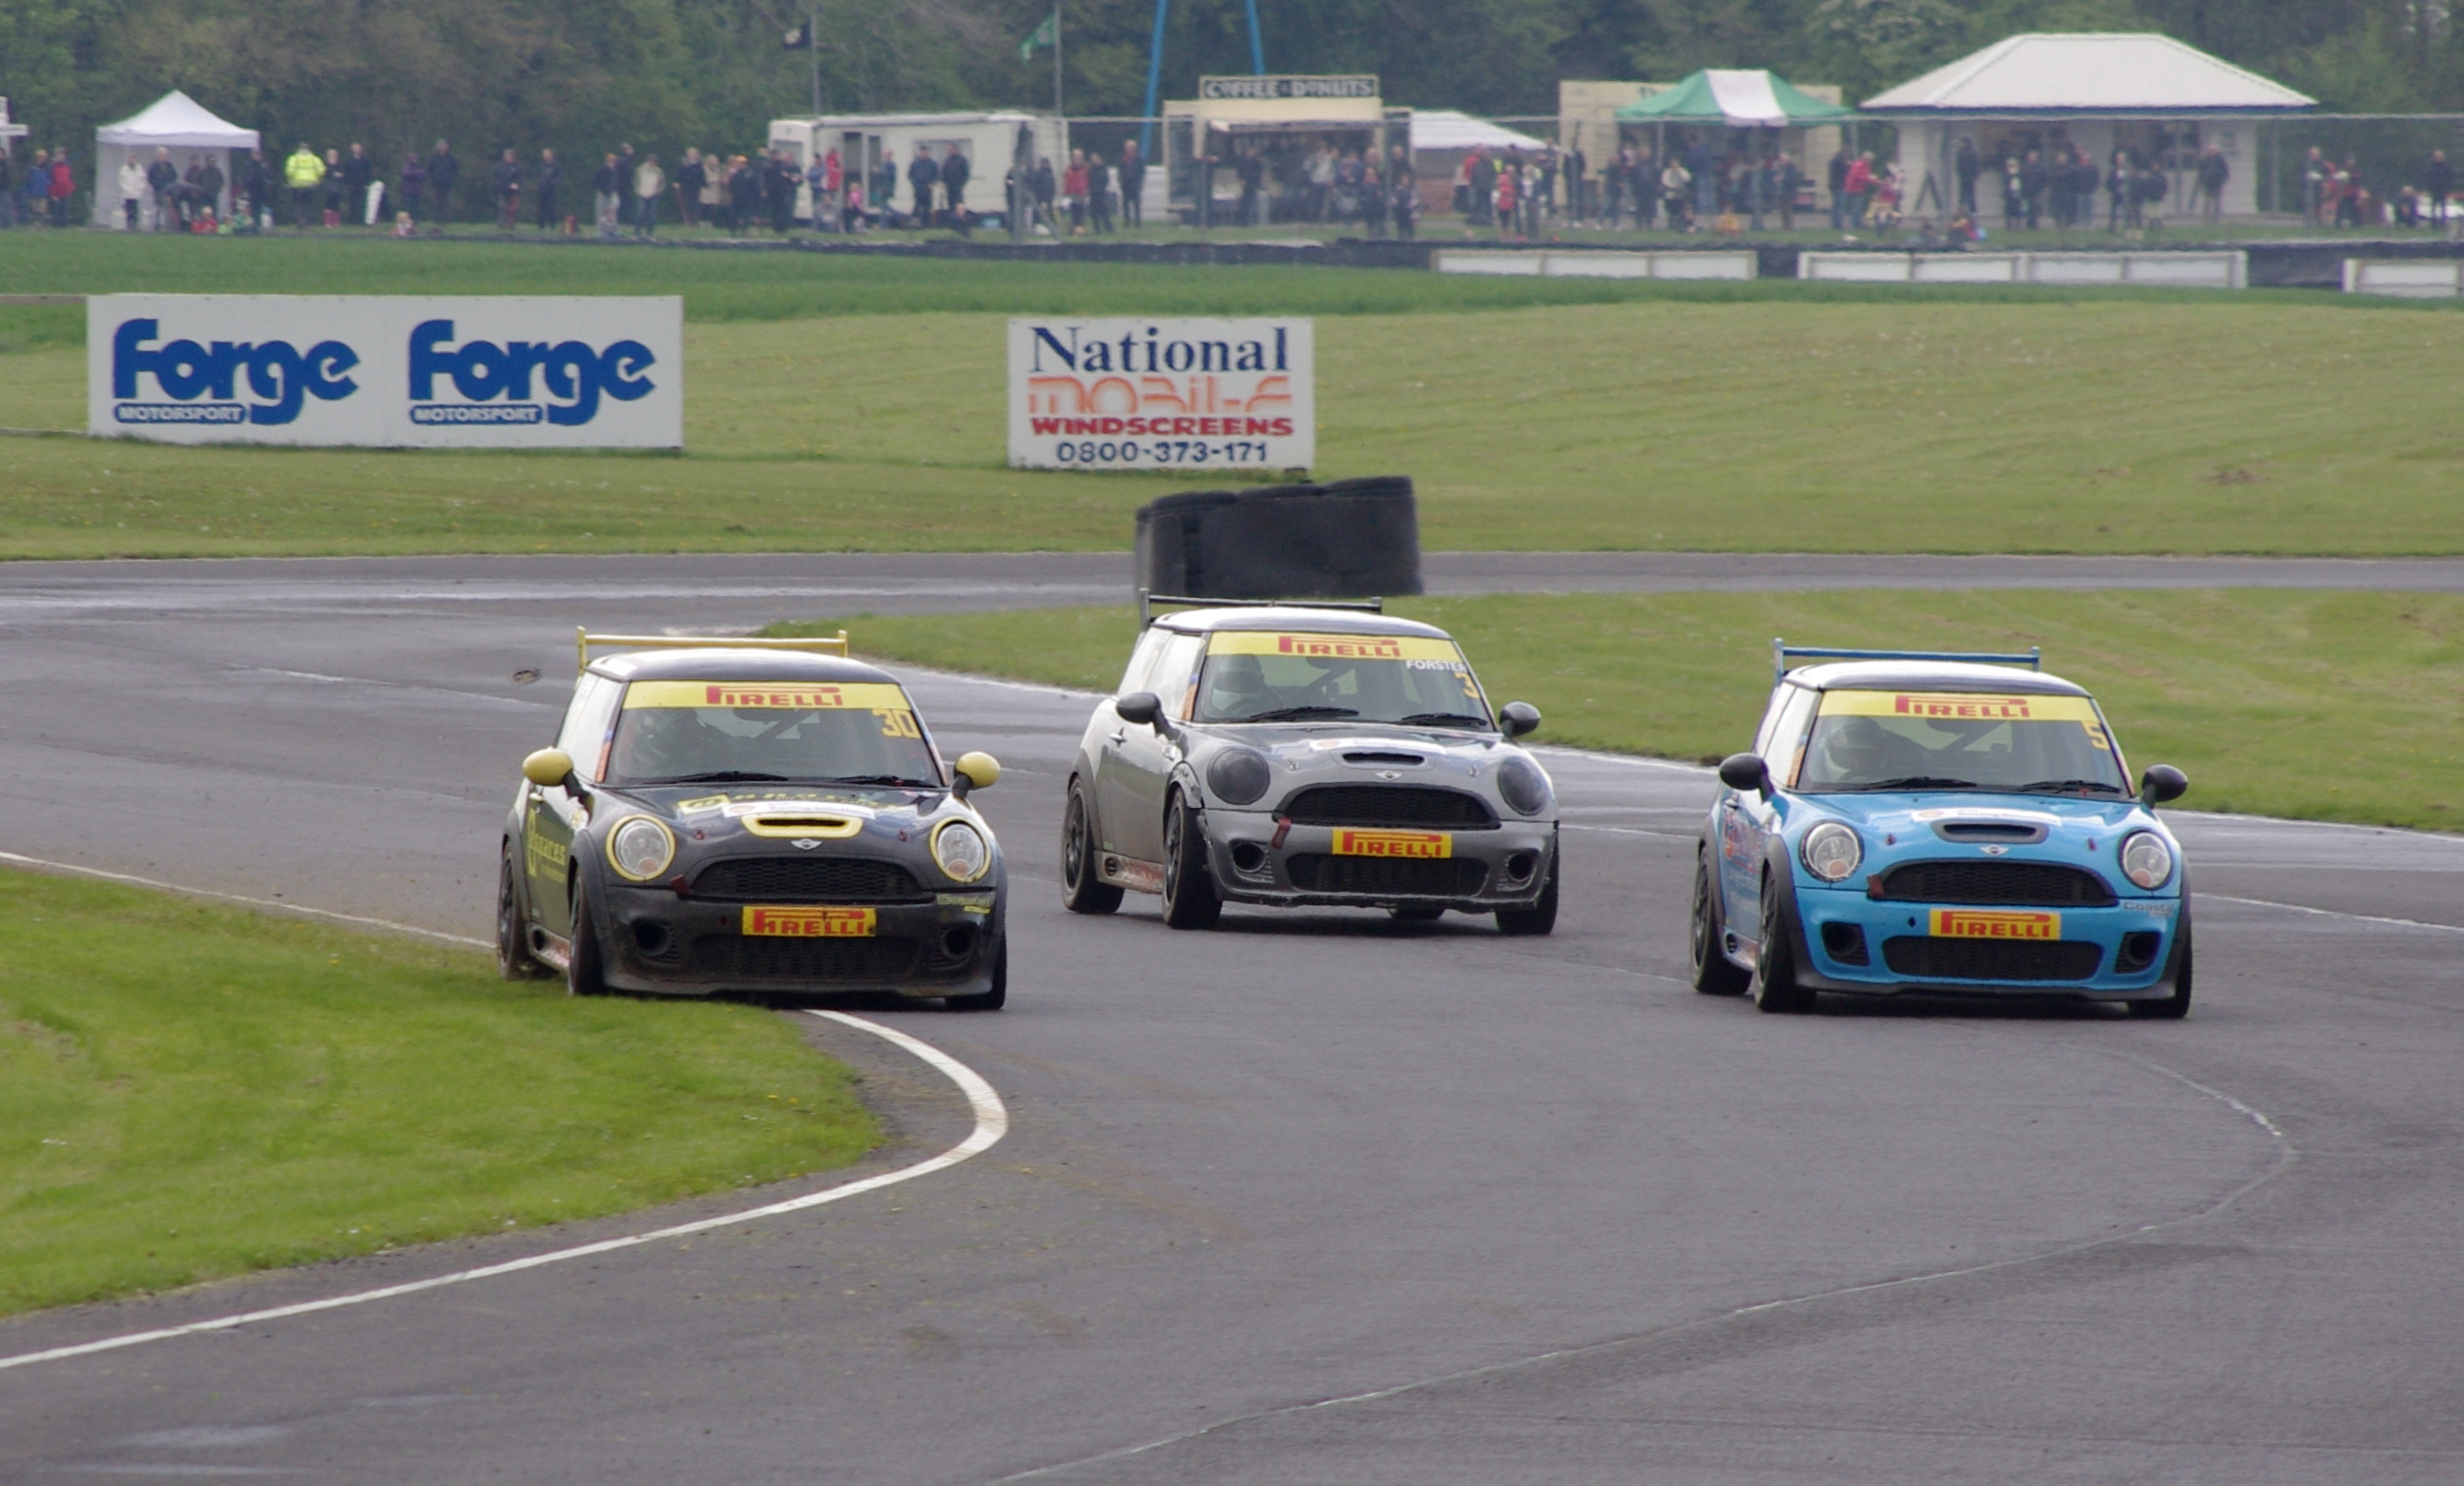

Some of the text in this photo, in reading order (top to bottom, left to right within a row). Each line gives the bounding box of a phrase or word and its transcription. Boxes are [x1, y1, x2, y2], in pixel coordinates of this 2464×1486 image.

[1206, 79, 1373, 97] COFFEE DONUTS
[1028, 326, 1291, 373] National
[117, 404, 243, 423] MOTORSPORT
[414, 405, 540, 423] MOTORSPORT
[1029, 417, 1294, 436] WINDSCREENS
[1056, 442, 1269, 463] 0800-373-171
[1278, 636, 1401, 657] PIRELLI
[706, 686, 843, 706] PIRELLI
[1453, 672, 1480, 699] 3
[1895, 695, 2031, 718] PIRELLI
[872, 709, 921, 738] 30
[2081, 721, 2111, 751] 5
[1342, 832, 1442, 857] PIRELLI
[753, 909, 865, 934] PIRELLI
[1940, 911, 2051, 938] PIRELLI
